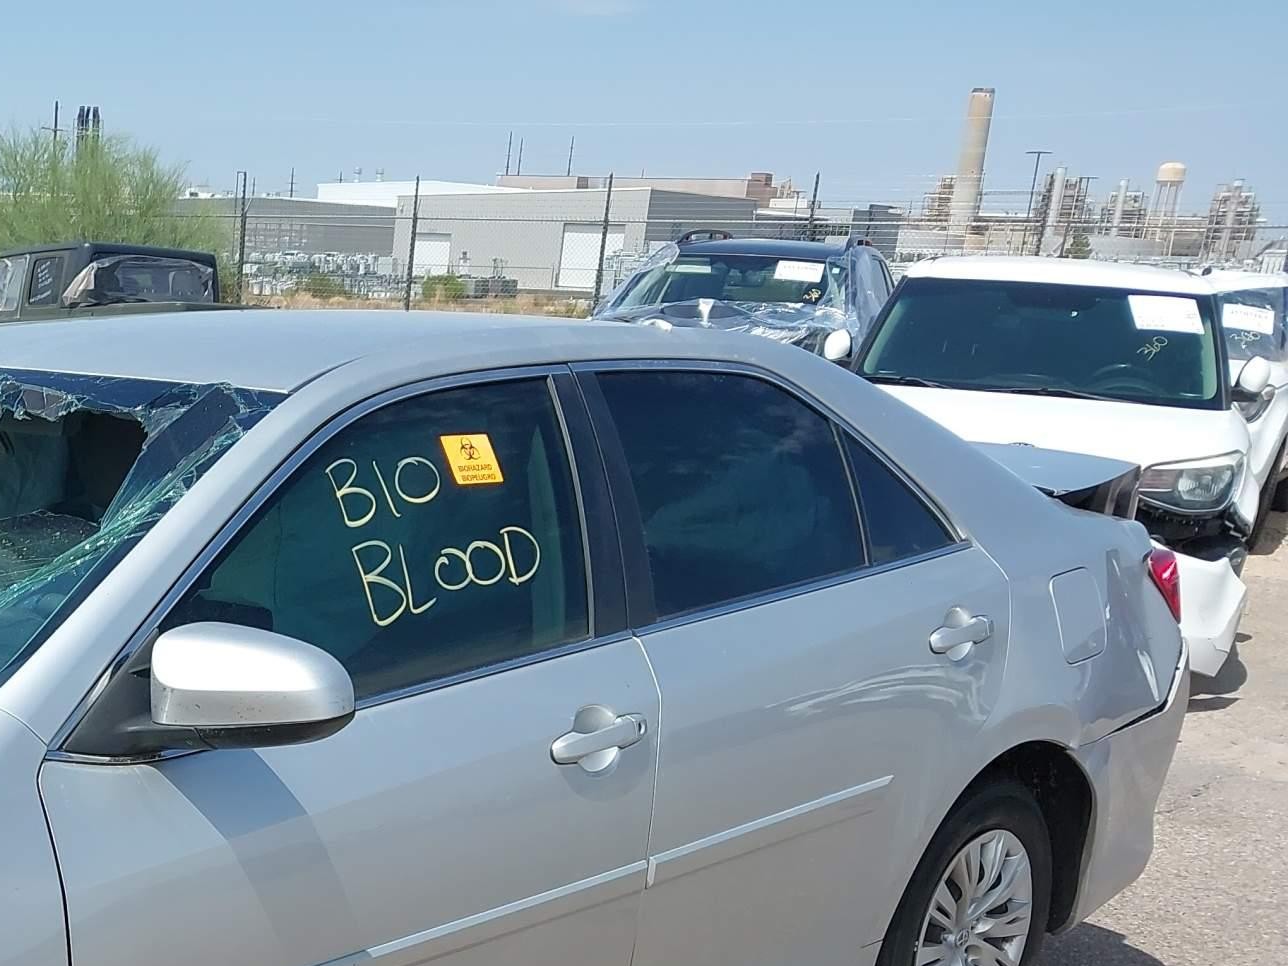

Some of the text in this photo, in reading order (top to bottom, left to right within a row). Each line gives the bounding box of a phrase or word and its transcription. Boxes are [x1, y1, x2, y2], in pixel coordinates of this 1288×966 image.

[1136, 335, 1168, 361] 360
[324, 456, 441, 528] BIO
[457, 463, 493, 473] BIOHAZARD
[351, 525, 541, 627] BLOOD
